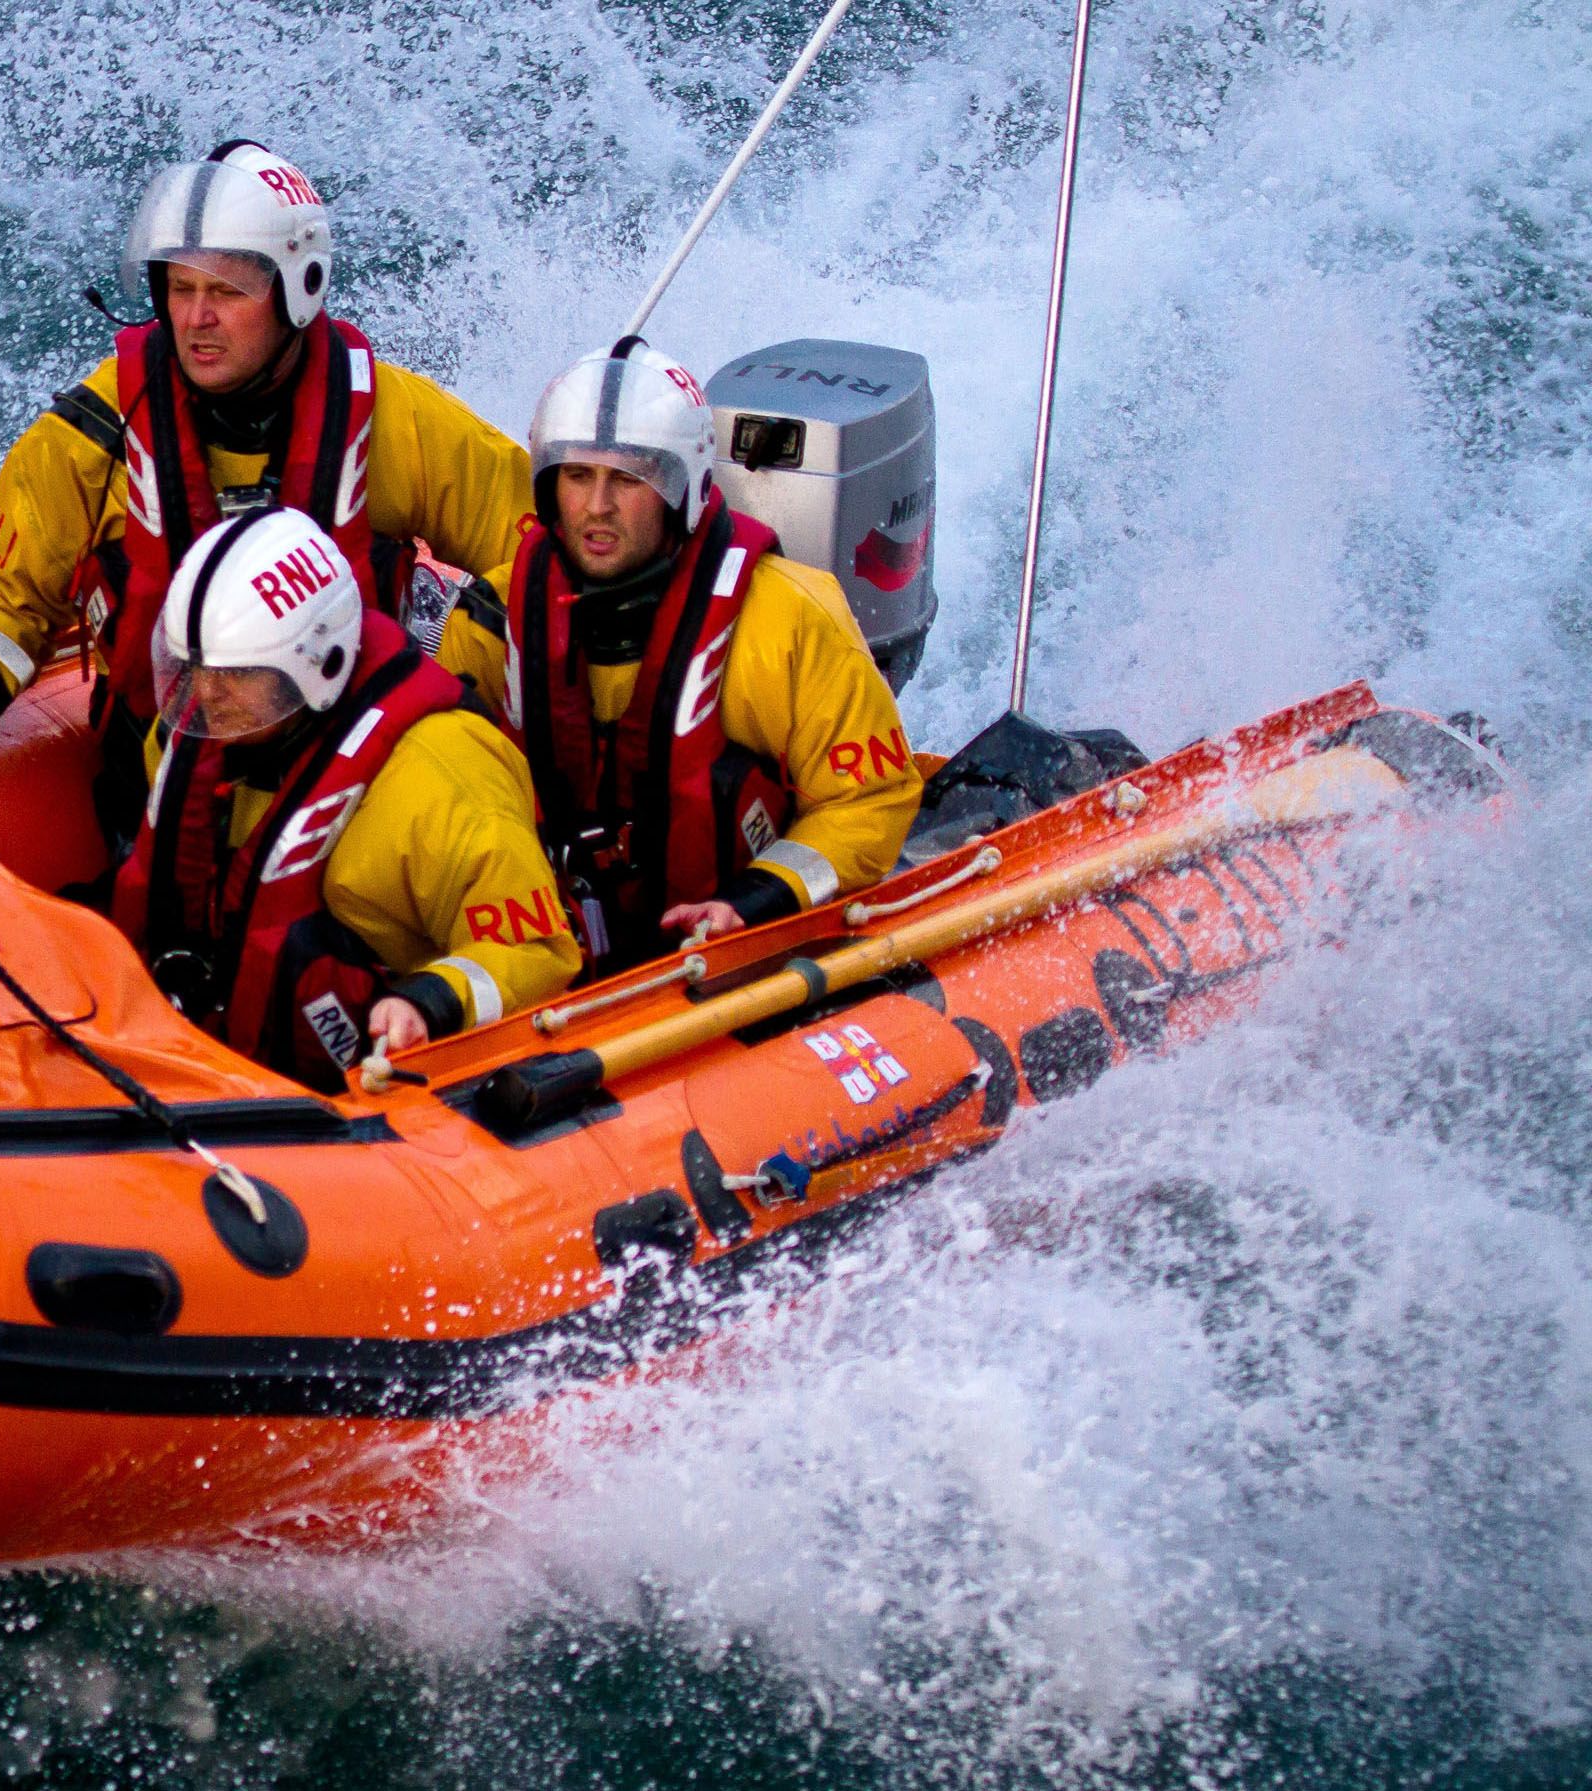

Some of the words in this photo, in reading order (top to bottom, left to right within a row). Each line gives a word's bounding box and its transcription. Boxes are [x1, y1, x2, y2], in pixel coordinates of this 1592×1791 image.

[735, 364, 891, 397] RNLI
[251, 538, 339, 619] RNLI
[829, 727, 908, 785] RN
